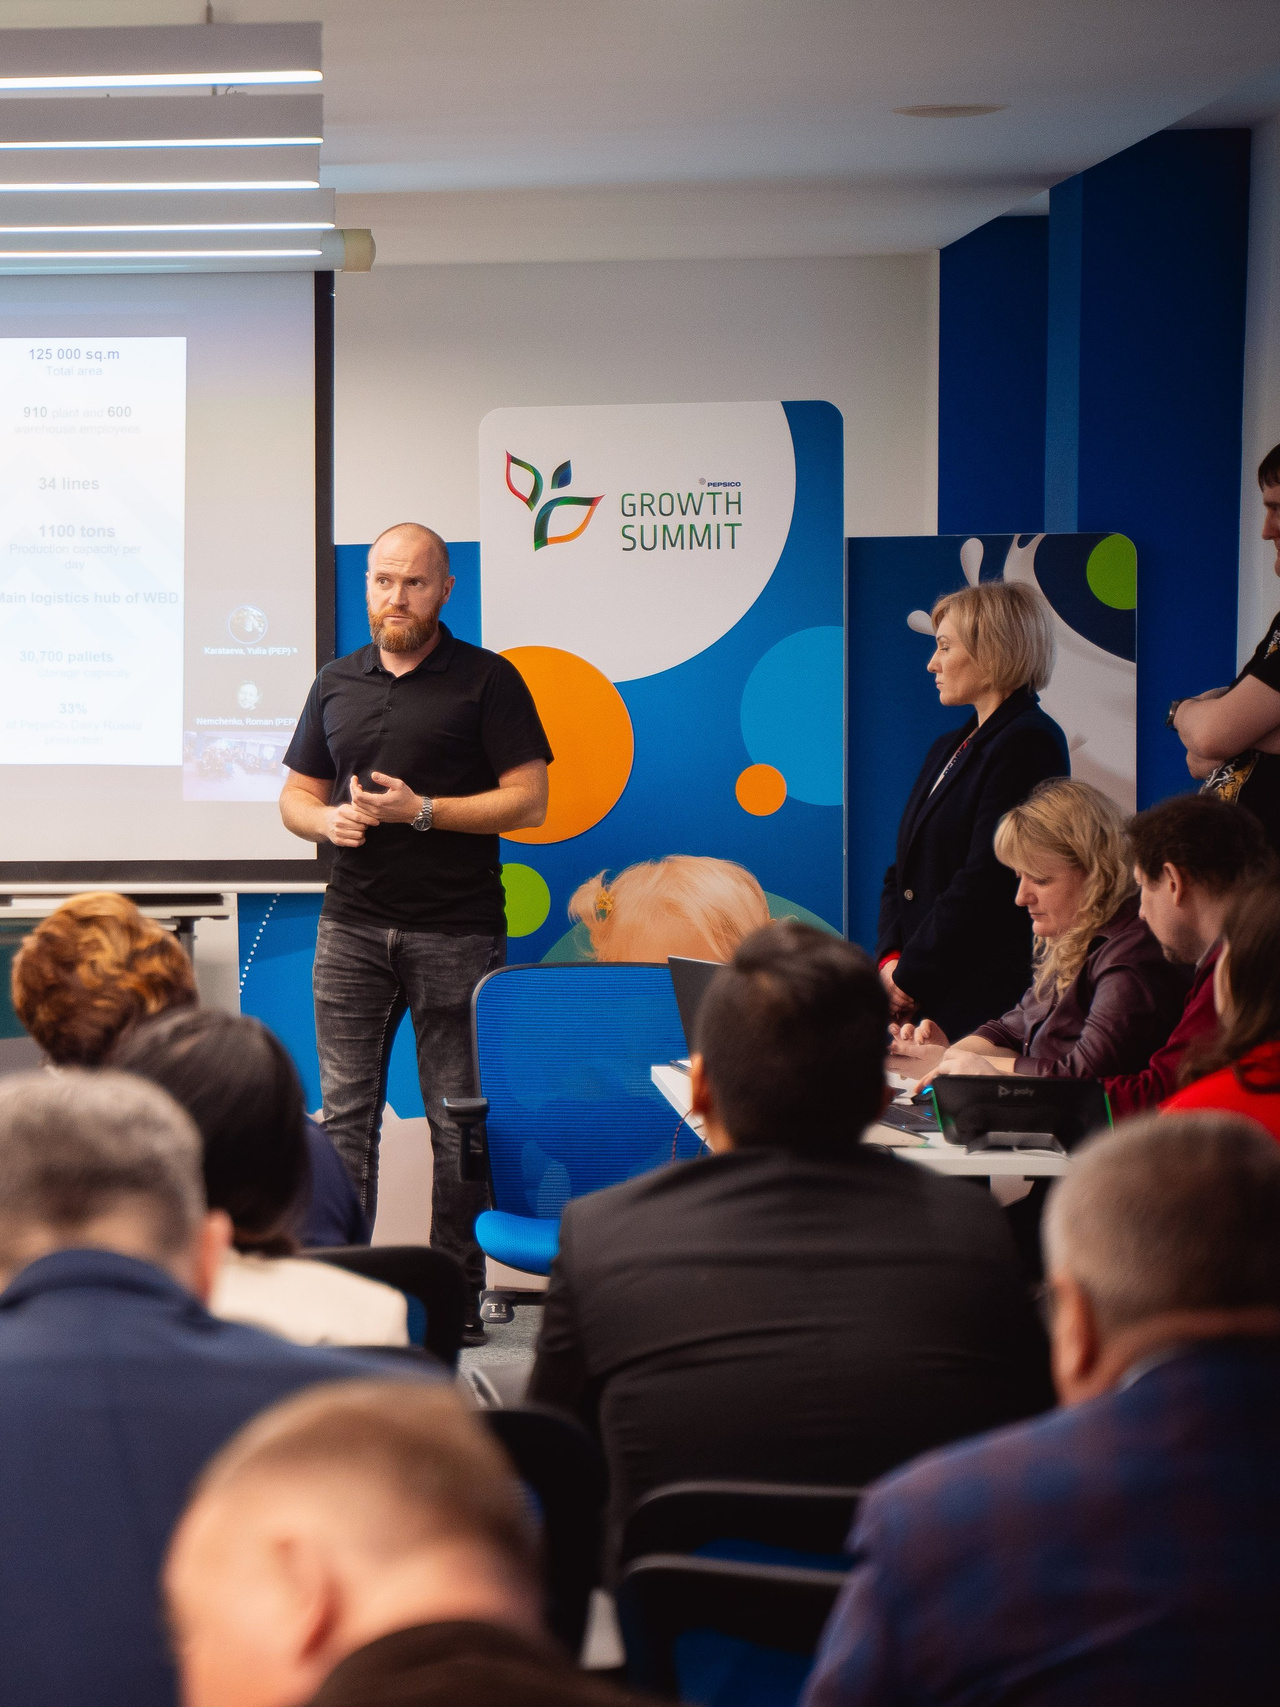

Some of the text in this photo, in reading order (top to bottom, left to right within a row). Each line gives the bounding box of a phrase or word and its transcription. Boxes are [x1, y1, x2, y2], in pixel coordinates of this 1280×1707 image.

[28, 348, 121, 363] 125 000 sq.m
[46, 365, 103, 376] Total area
[23, 405, 132, 420] 910 plant and 600
[14, 423, 141, 436] warehouse employees
[38, 477, 100, 490] 34 lines
[621, 492, 742, 517] GROWTH
[38, 525, 116, 538] 1100 tons
[621, 523, 742, 551] SUMMIT
[9, 543, 141, 557] Production capacity per
[64, 560, 85, 572] day
[31, 591, 89, 606] logistics
[94, 591, 121, 604] hub
[125, 591, 139, 604] of
[142, 592, 179, 604] WBD
[19, 651, 114, 664] 30,700 pallets
[59, 702, 88, 715] 33%
